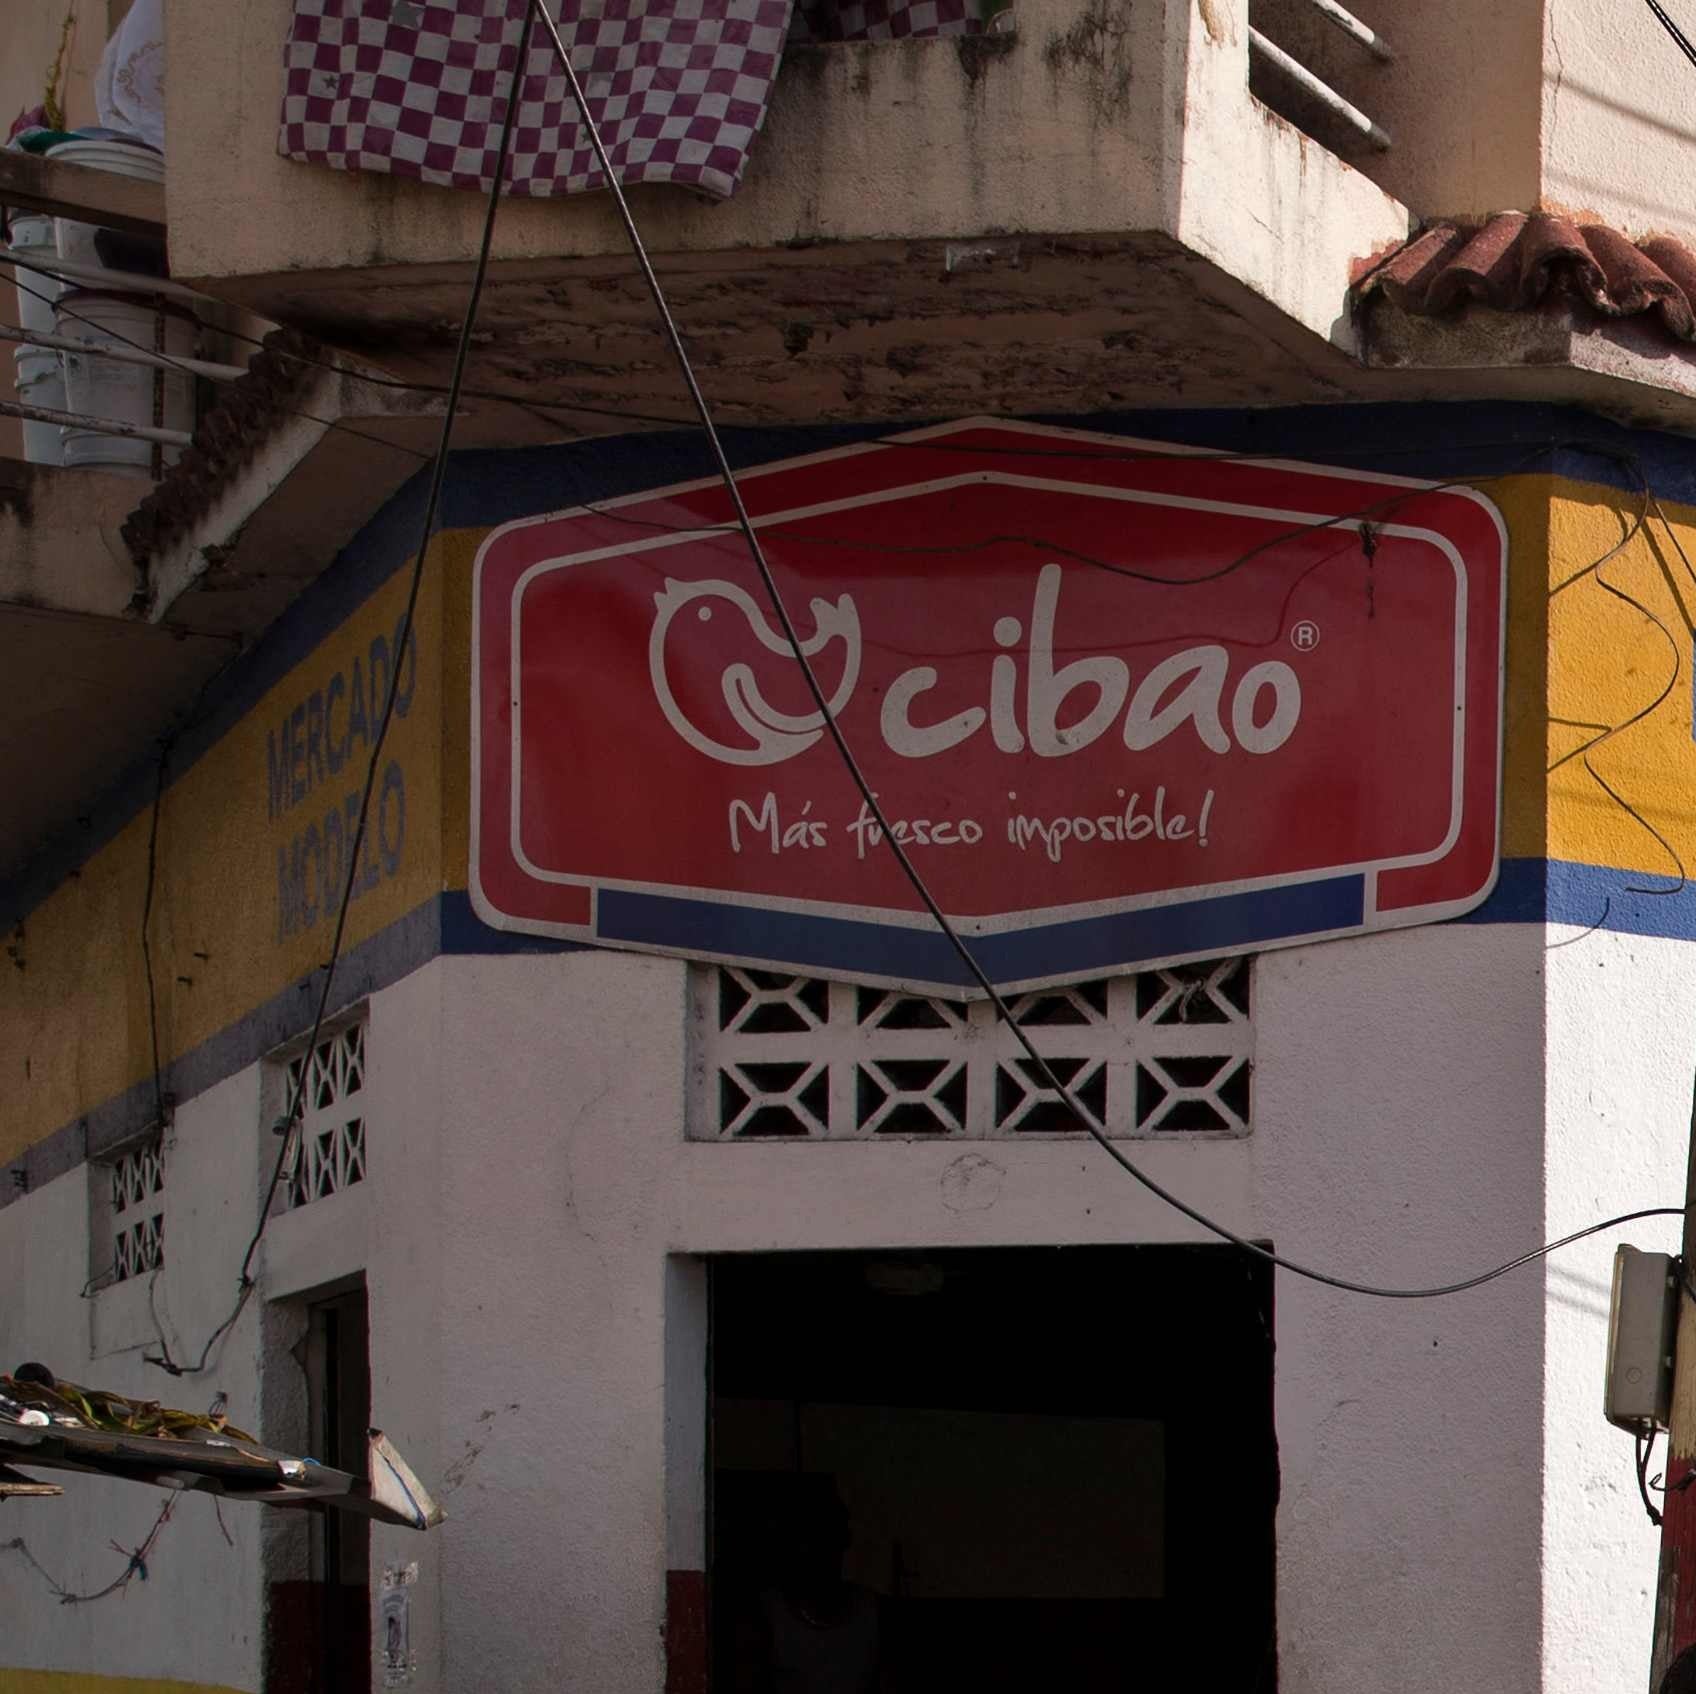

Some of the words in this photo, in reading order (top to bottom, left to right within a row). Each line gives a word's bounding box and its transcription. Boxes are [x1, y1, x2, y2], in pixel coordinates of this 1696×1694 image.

[267, 613, 418, 825] MERCADO
[880, 563, 1302, 758] cibao
[277, 760, 407, 944] MODELO
[728, 791, 828, 855] Más
[1007, 786, 1216, 863] imposible!
